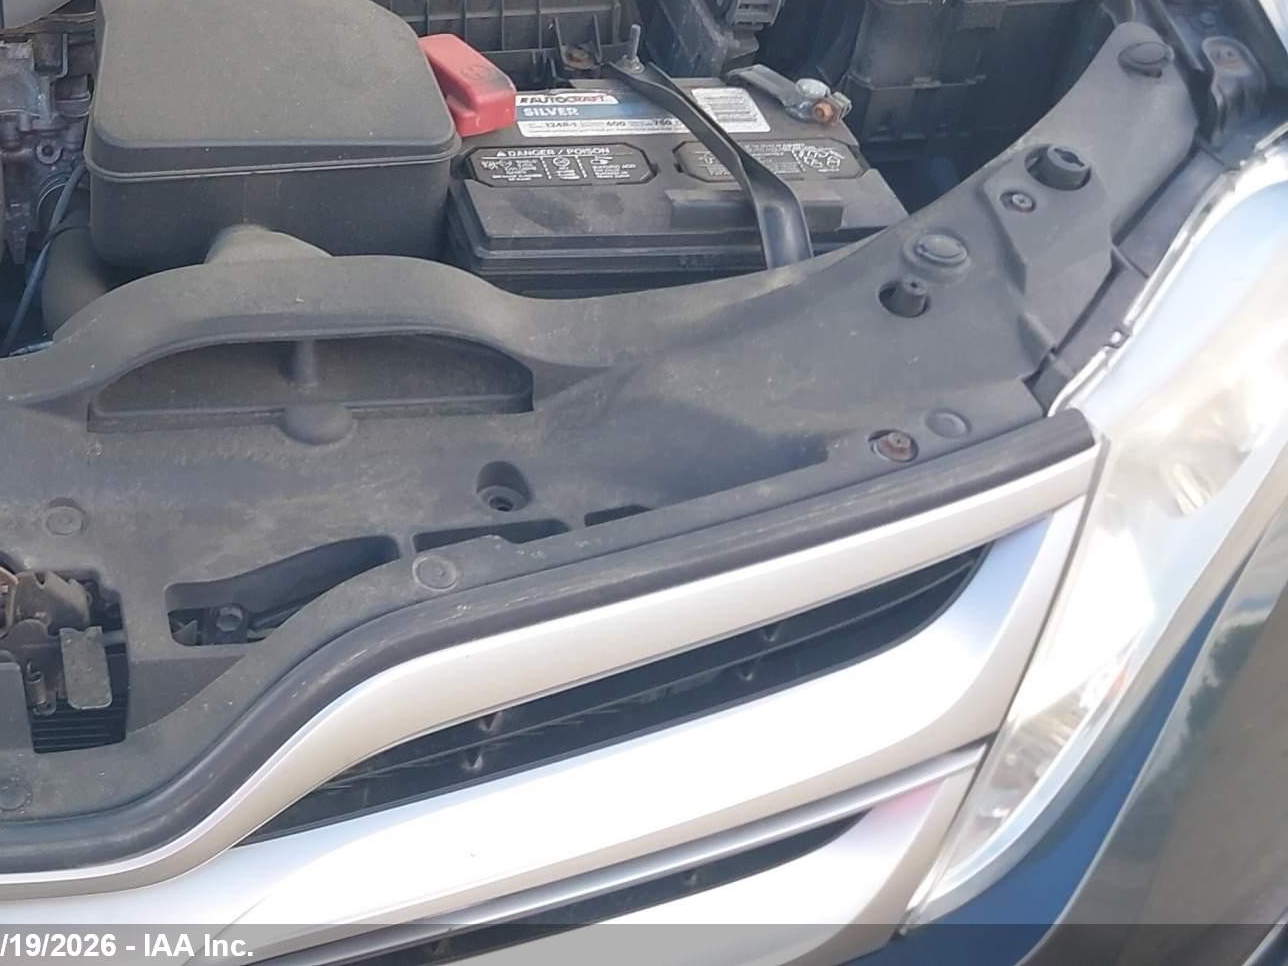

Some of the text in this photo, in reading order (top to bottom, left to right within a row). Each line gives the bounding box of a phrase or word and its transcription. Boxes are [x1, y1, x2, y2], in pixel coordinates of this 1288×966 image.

[528, 93, 605, 104] AUTOCRAFT
[523, 107, 580, 117] SILVER
[506, 149, 555, 157] DANGER
[566, 147, 611, 156] POISON
